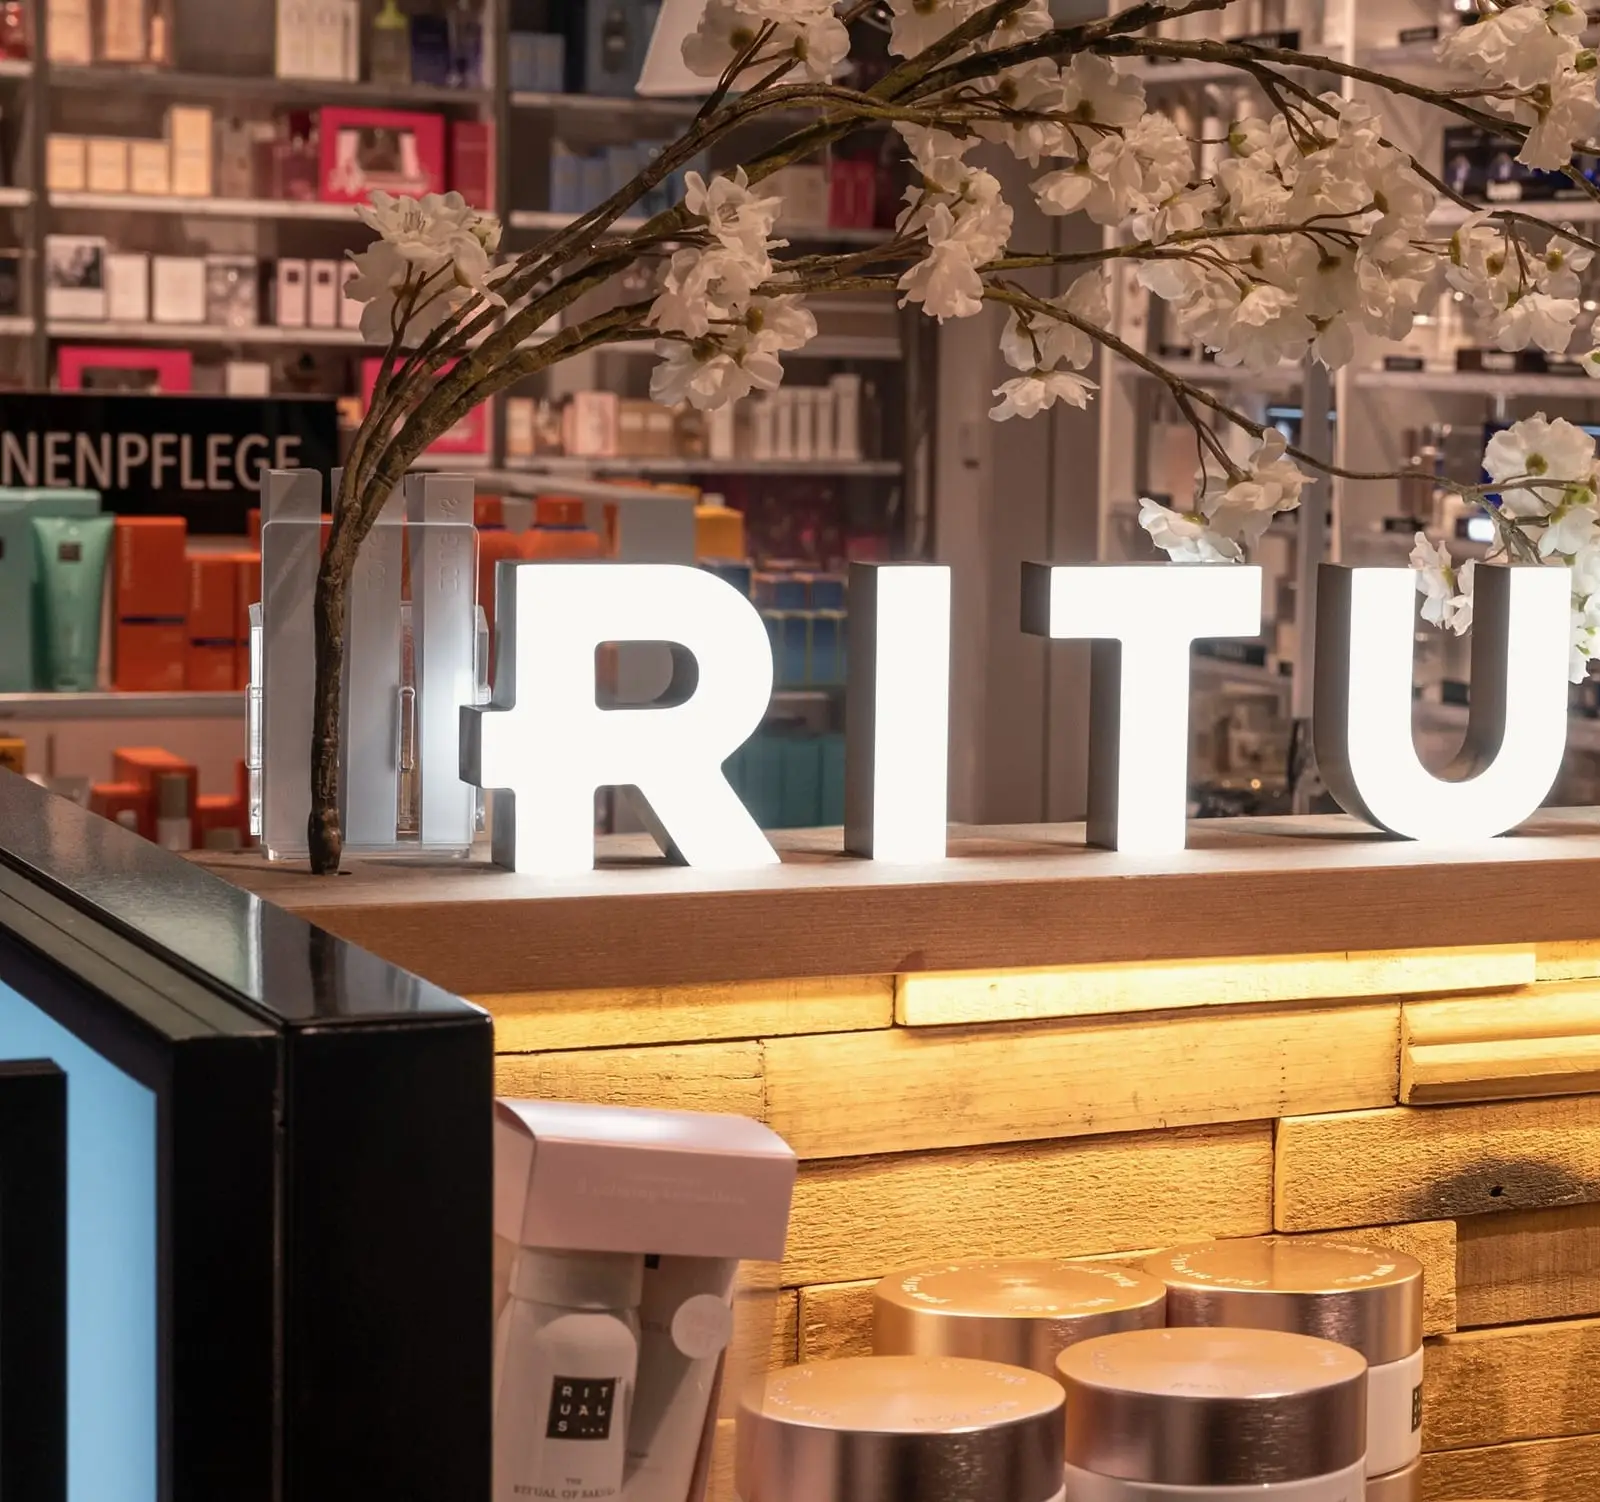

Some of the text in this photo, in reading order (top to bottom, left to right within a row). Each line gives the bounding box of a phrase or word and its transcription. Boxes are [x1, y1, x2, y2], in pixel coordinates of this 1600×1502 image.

[0, 431, 301, 490] NENPFLEGE
[513, 1484, 557, 1498] RITUAL
[561, 1489, 577, 1499] OF
